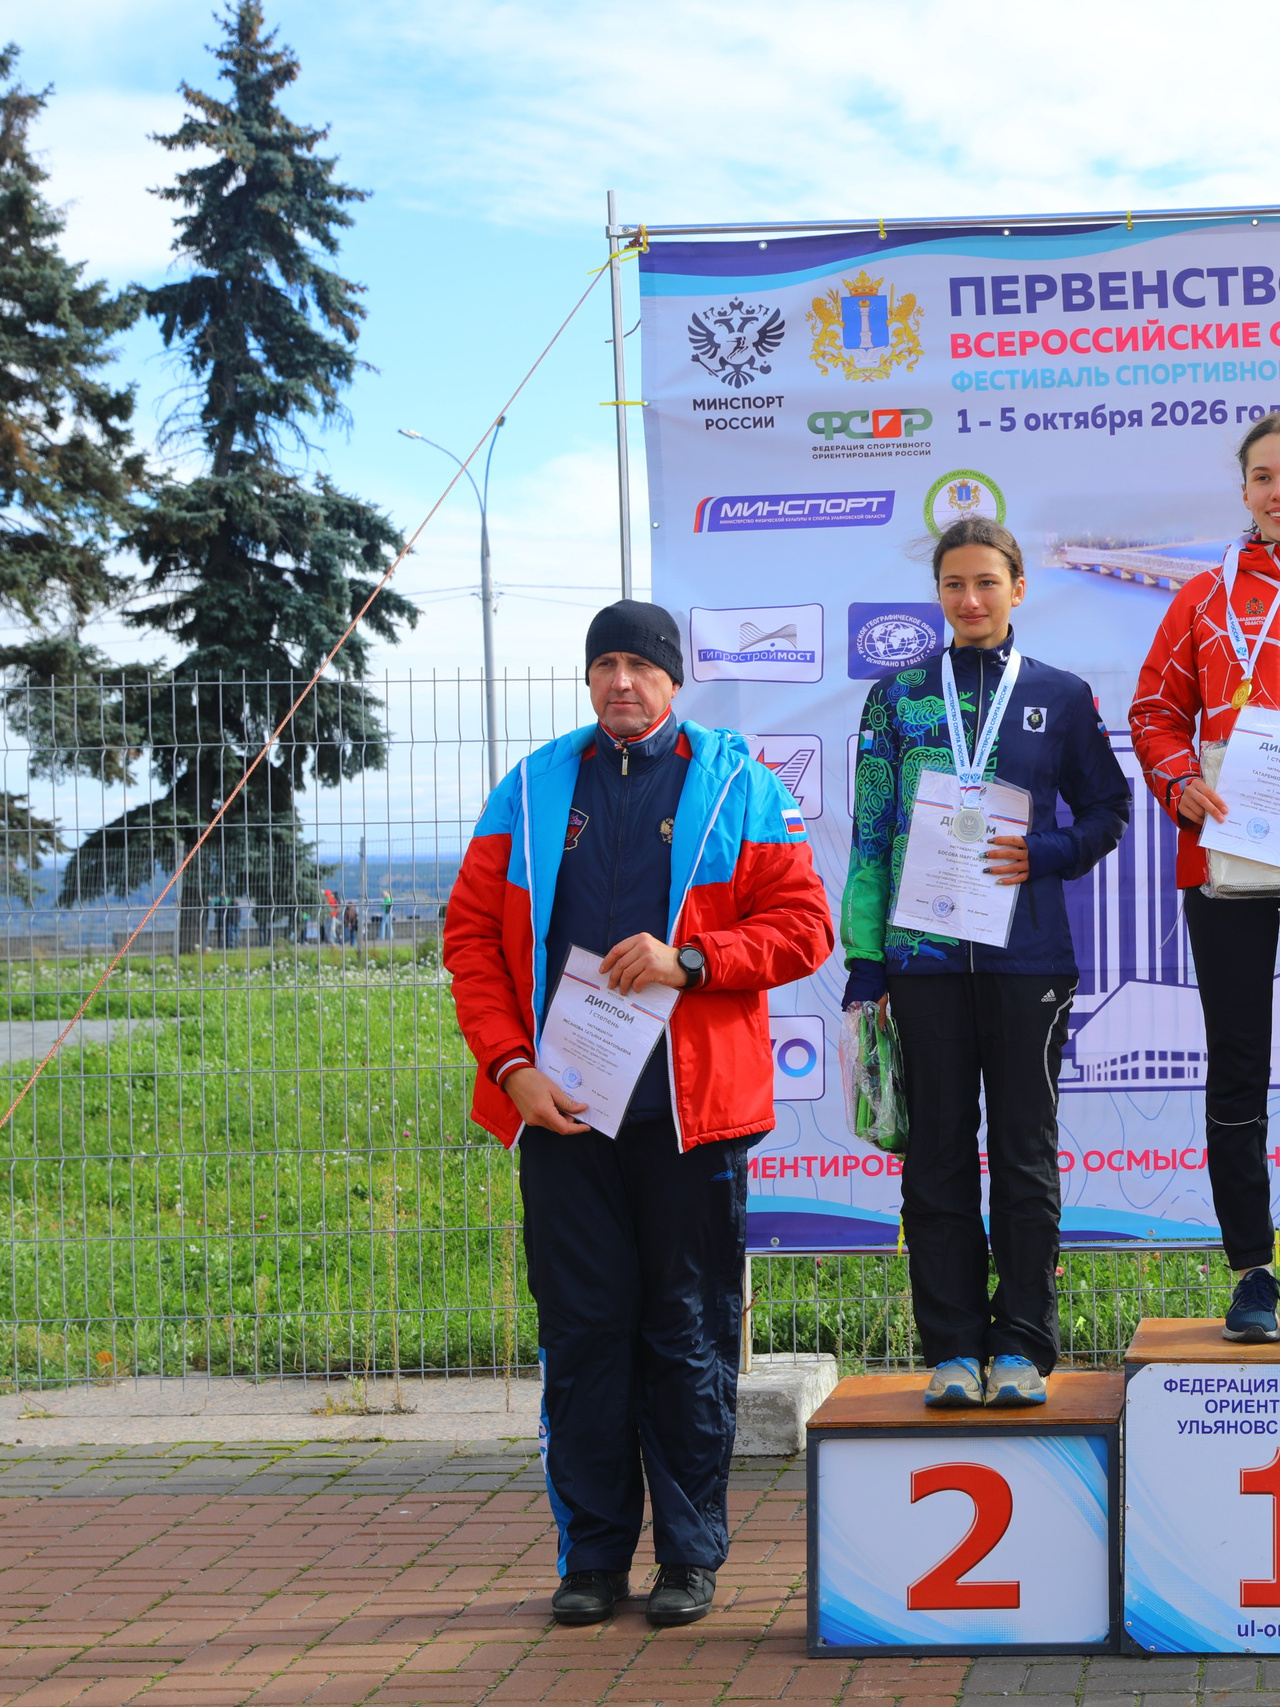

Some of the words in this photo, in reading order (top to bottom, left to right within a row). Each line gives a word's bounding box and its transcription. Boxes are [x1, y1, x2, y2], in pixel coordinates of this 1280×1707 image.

[951, 319, 1261, 359] ВСЕРОССИЙСКИЕ
[951, 366, 1110, 392] ФЕСТИВАЛЬ
[692, 395, 785, 411] МИНСПОРТ
[705, 416, 775, 430] РОССИИ
[957, 409, 971, 433] 1
[1000, 407, 1016, 432] 5
[1024, 404, 1143, 435] октября
[1151, 399, 1228, 426] 2026
[811, 444, 865, 452] ФЕДЕРАЦИЯ
[867, 442, 931, 450] СПОРТИВНОГО
[812, 452, 893, 460] ОРИЕНТИРОВАНИЯ
[720, 497, 886, 518] МИНСПОРТ
[865, 614, 922, 629] ГЕОГРАФИЧЕСКОЕ
[938, 850, 959, 858] БОСОВА
[584, 994, 635, 1024] ДИПЛОМ
[592, 1012, 620, 1029] степень
[1163, 1378, 1278, 1394] ФЕДЕРАЦИЯ
[907, 1461, 1020, 1611] 2
